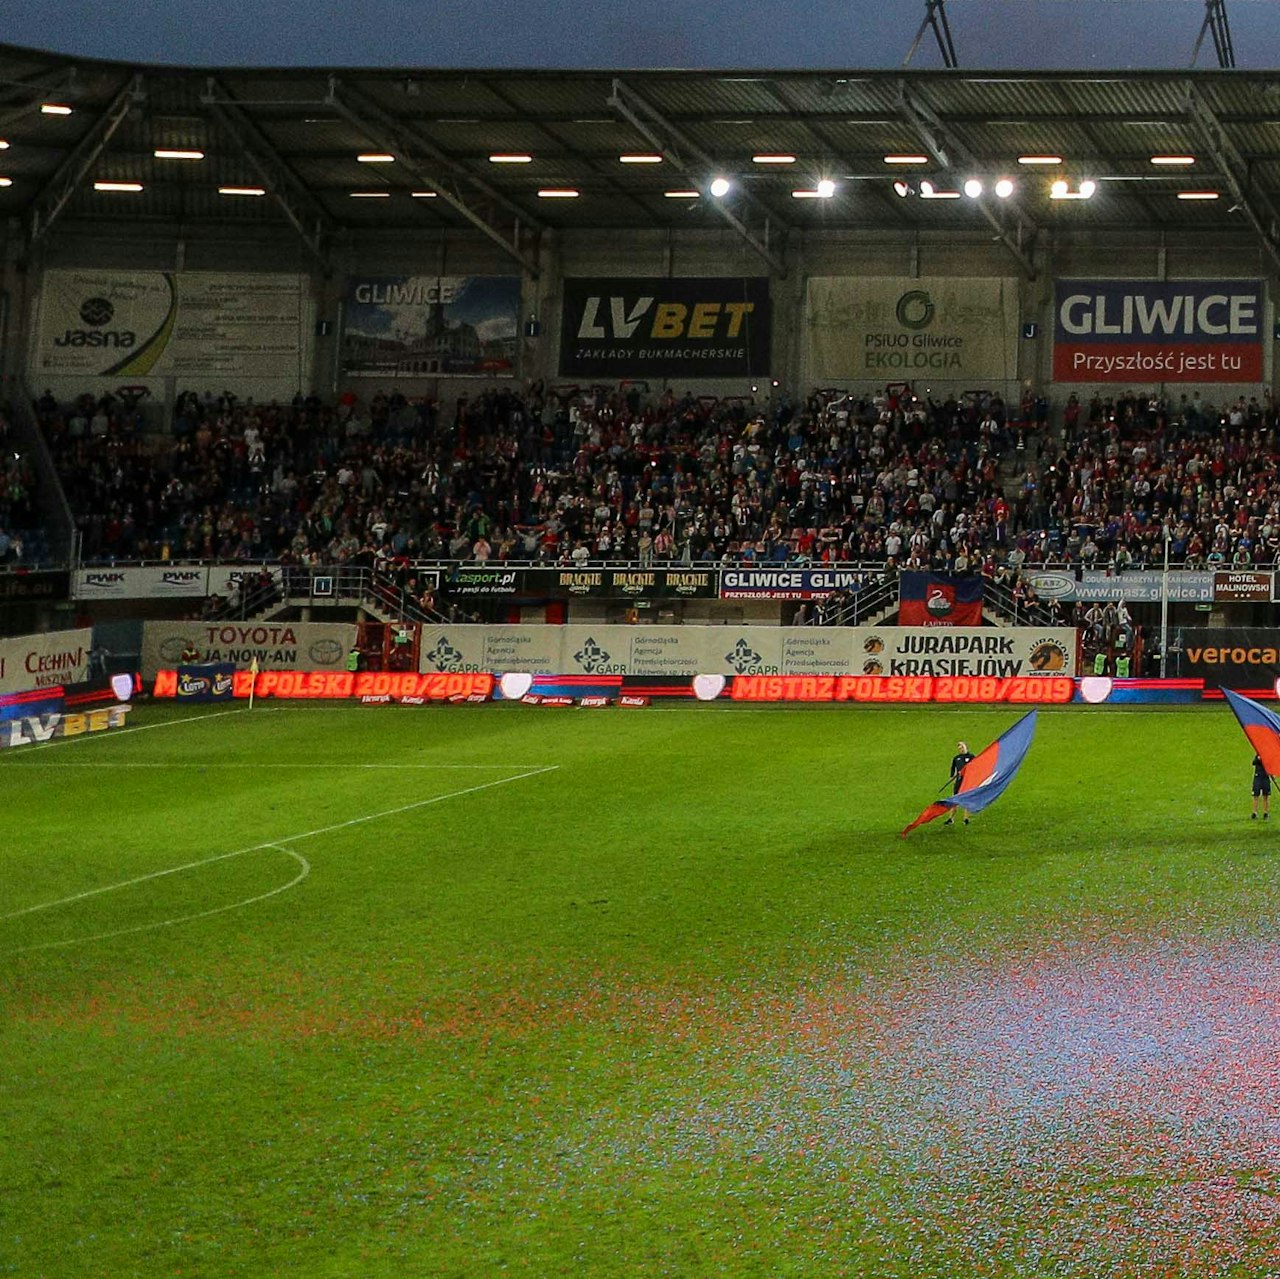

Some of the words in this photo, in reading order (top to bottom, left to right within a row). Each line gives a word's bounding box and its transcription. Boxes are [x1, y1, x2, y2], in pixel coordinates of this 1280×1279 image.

[355, 284, 452, 305] GLIWICE
[1060, 294, 1257, 334] GLIWICE
[1025, 325, 1034, 338] J
[913, 334, 963, 347] Gliwice
[576, 349, 634, 359] ZAKŁADY
[638, 349, 744, 359] BUKMACHERSKIE
[1073, 352, 1174, 373] Przyszłość
[1177, 353, 1215, 373] jest
[1221, 353, 1241, 369] tu
[560, 573, 602, 586] BRACKIE
[613, 573, 655, 586] BRACKIE
[666, 573, 708, 586] BRACKIE
[725, 573, 802, 588] GLIWICE
[1229, 574, 1257, 583] HOTEL
[1216, 583, 1270, 592] MALINOWSKI
[725, 591, 771, 599] PRZYSZŁOŚĆ
[206, 626, 297, 645] TOYOTA
[896, 636, 1015, 654] JURAPARK
[450, 664, 479, 674] GAPR
[596, 664, 627, 674] GAPR
[748, 665, 778, 676] GAPR
[890, 655, 1023, 677] KRASIEJÓW
[260, 671, 351, 696] POLSKI
[358, 673, 493, 696] 2018/2019
[736, 678, 834, 700] MISTRZ
[842, 678, 932, 700] POLSKI
[938, 679, 1071, 700] 2018/2019
[580, 697, 607, 706] Henryk
[621, 696, 644, 706] Kania
